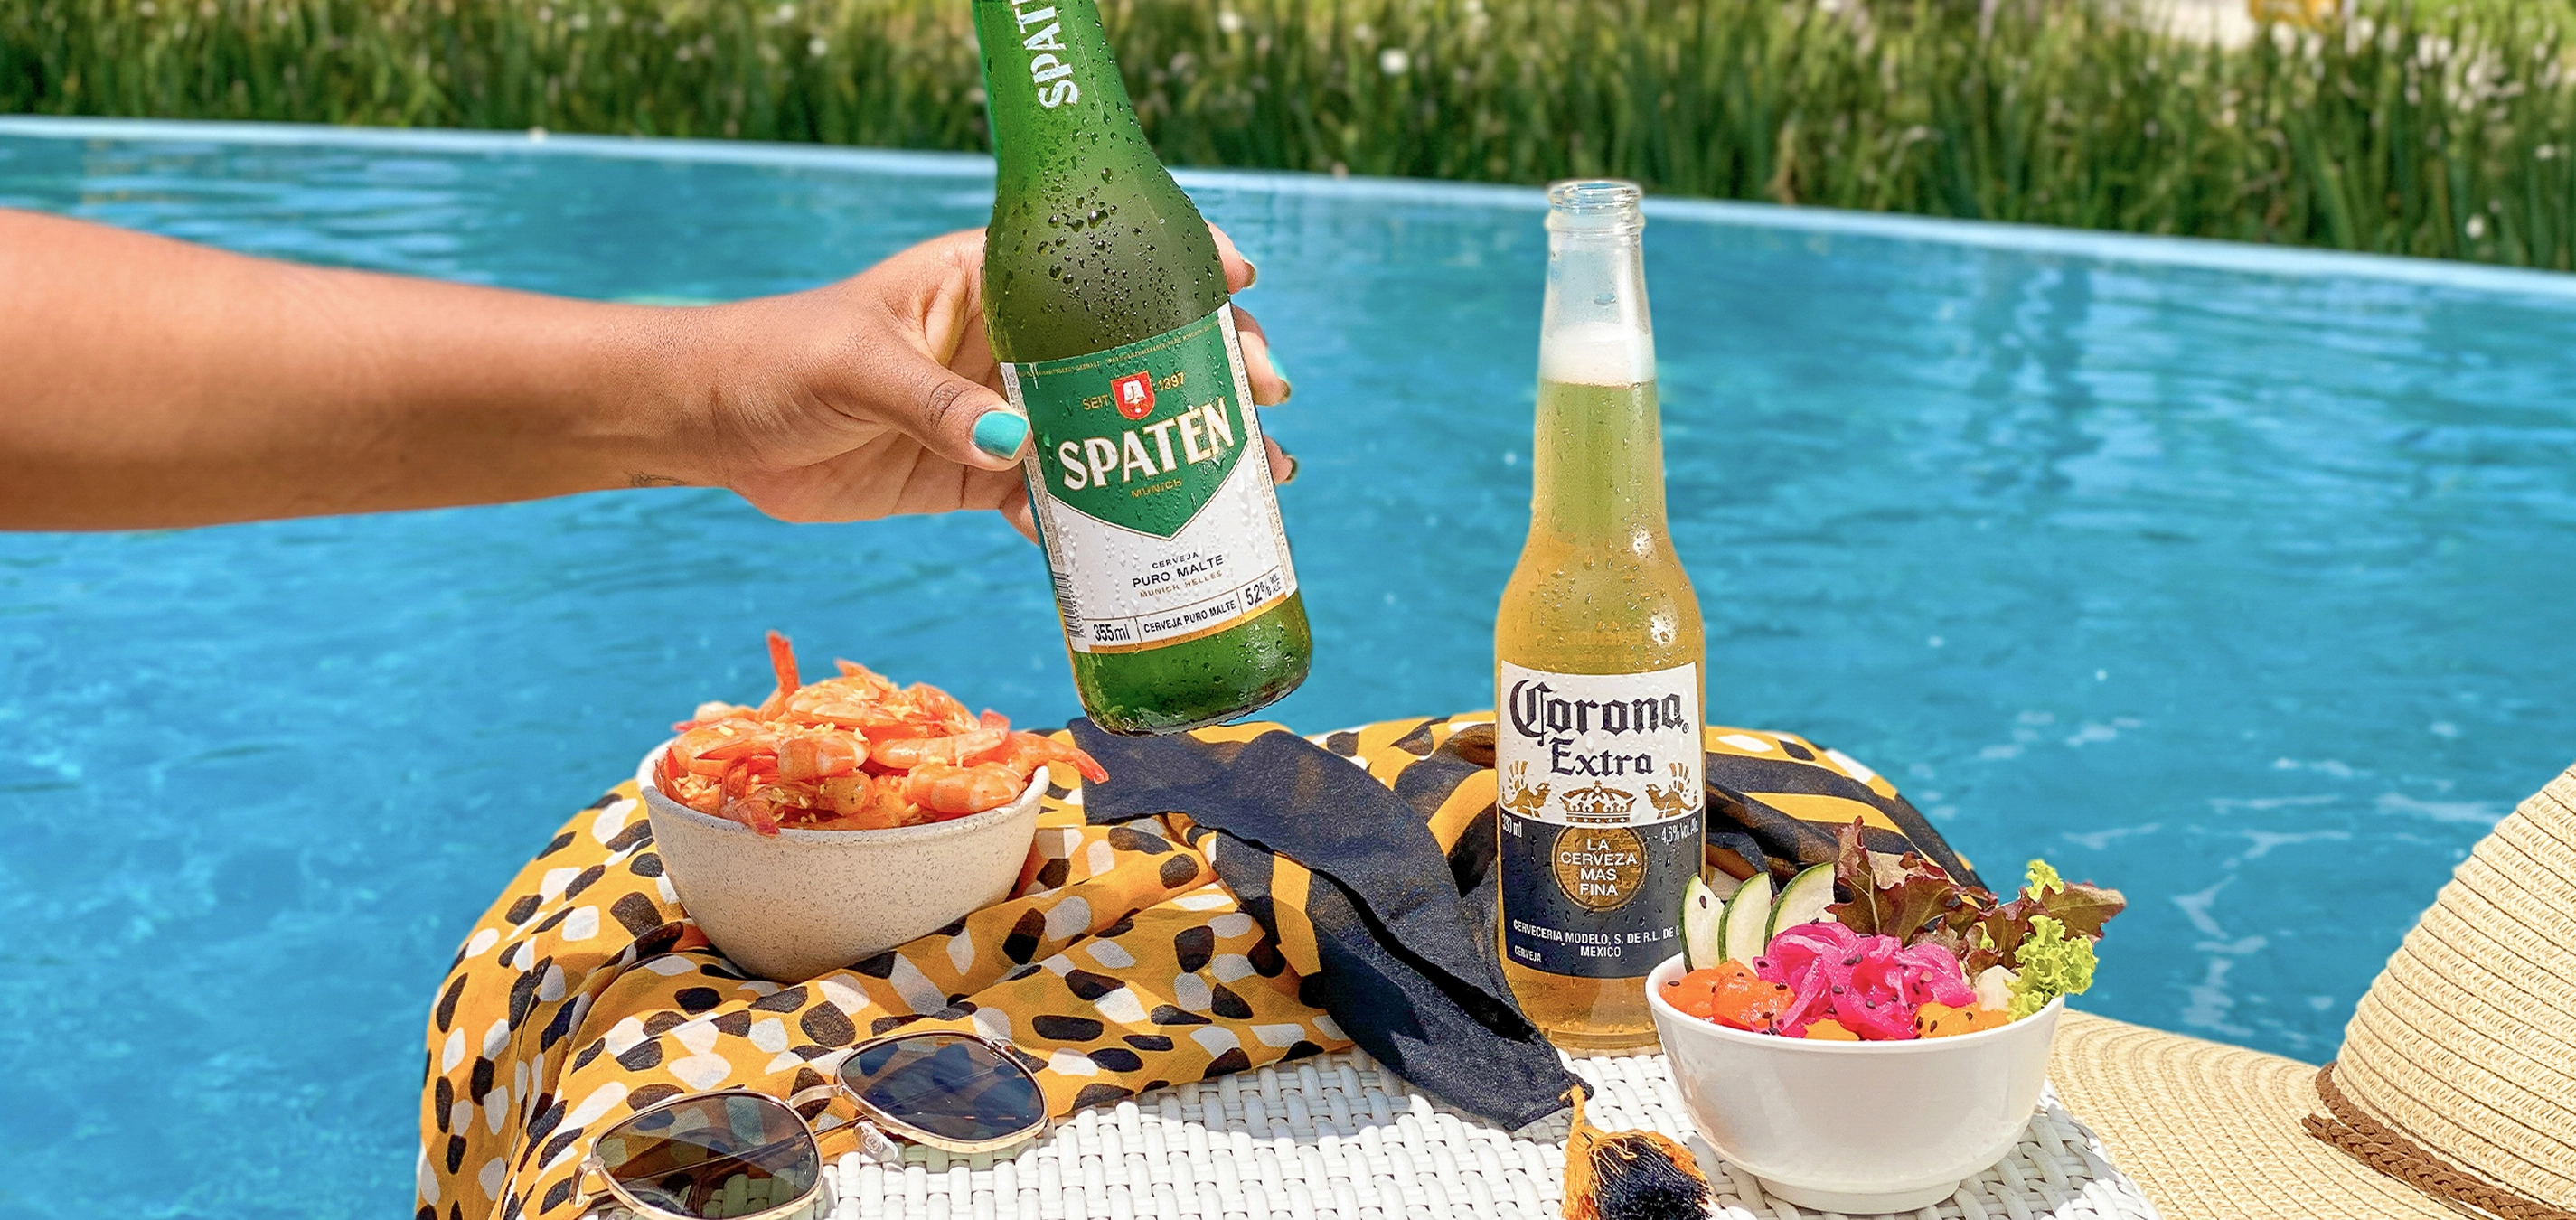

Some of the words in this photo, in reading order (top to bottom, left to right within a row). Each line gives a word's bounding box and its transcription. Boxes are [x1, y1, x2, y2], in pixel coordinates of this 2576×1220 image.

[1011, 0, 1079, 108] SPAT
[1082, 394, 1109, 410] SEIT
[1158, 371, 1185, 392] 1397
[1058, 397, 1235, 491] SPATEN
[1131, 477, 1182, 498] MUNICH
[1132, 572, 1170, 587] PURO
[1176, 554, 1224, 577] MALTE
[1152, 552, 1199, 568] CERVEJA
[1140, 584, 1180, 597] MUNICH
[1185, 570, 1222, 587] HELLES
[1143, 616, 1182, 633] CERVEJA
[1184, 612, 1208, 625] PURO
[1209, 599, 1236, 617] MALTE
[1093, 624, 1130, 642] 355ml
[1509, 680, 1684, 746] Corona
[1549, 737, 1654, 777] Extra
[1586, 839, 1610, 851] LA
[1560, 851, 1638, 866] CERVEZA
[1580, 868, 1617, 881] MAS
[1579, 884, 1619, 896] FINA
[1513, 919, 1564, 941] CERVECERIA
[1565, 933, 1611, 945] MODELO,
[1614, 934, 1624, 944] S.
[1627, 932, 1641, 943] DE
[1643, 931, 1660, 943] R.L.
[1662, 927, 1673, 939] DE
[1514, 945, 1542, 963] CERVEJA
[1580, 946, 1621, 958] MEXICO
